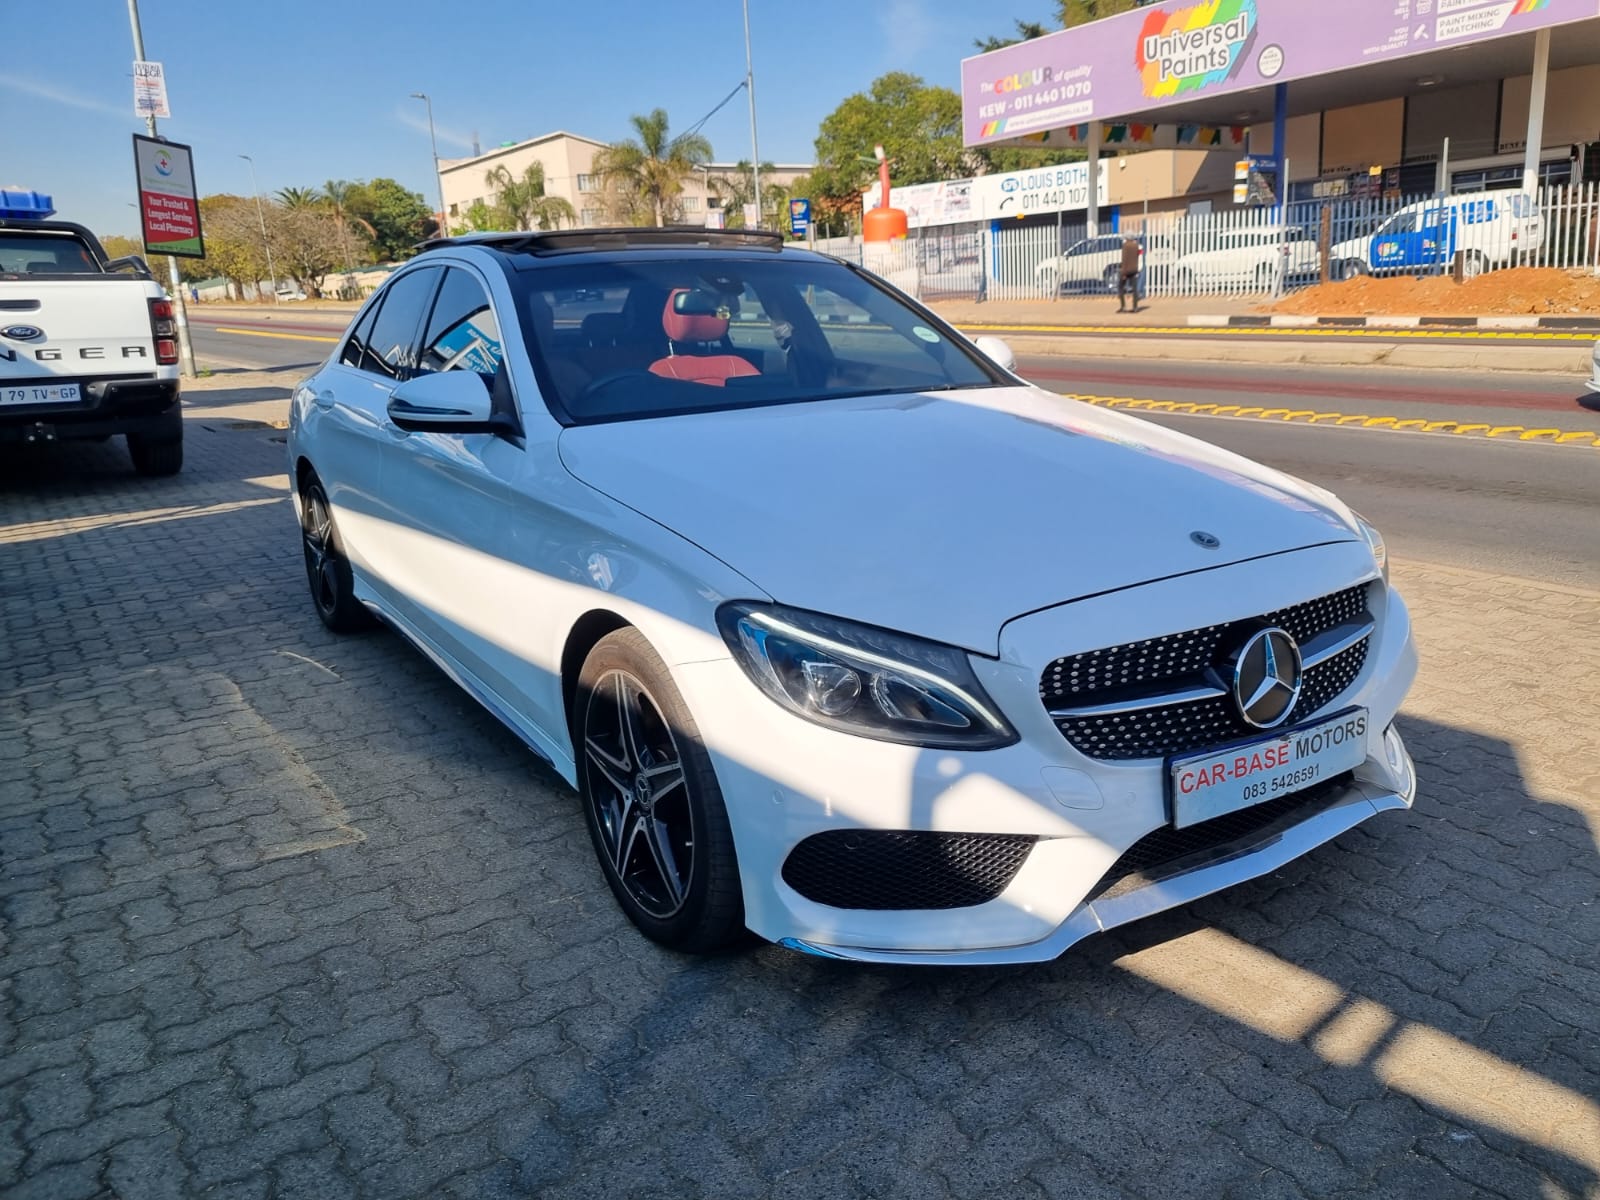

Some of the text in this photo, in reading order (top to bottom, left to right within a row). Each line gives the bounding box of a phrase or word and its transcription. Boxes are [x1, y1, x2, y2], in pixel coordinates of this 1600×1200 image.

[1440, 8, 1500, 28] PAINT MIXING
[1447, 19, 1494, 35] MATCHING
[1146, 15, 1246, 60] Universal
[1381, 40, 1408, 52] QUALITY
[1161, 48, 1227, 79] Paints
[980, 65, 1093, 95] The COLOUR of quality
[979, 101, 1006, 118] KEW
[1014, 93, 1033, 110] 011
[1034, 88, 1059, 106] 440
[1061, 81, 1092, 100] 1070
[1021, 173, 1053, 191] LOUIS
[1056, 168, 1087, 186] BOTH
[148, 196, 189, 211] Your Trusted &
[1023, 193, 1039, 209] 011
[1042, 190, 1065, 207] 440
[148, 208, 193, 225] Longest Serving
[150, 221, 194, 237] Local Pharmacy
[11, 326, 32, 336] Ford
[8, 390, 25, 401] 79
[34, 389, 48, 400] TV
[60, 388, 77, 399] GP
[1180, 716, 1366, 794] CAR-BASE MOTORS
[1243, 763, 1320, 801] 083 5426591
